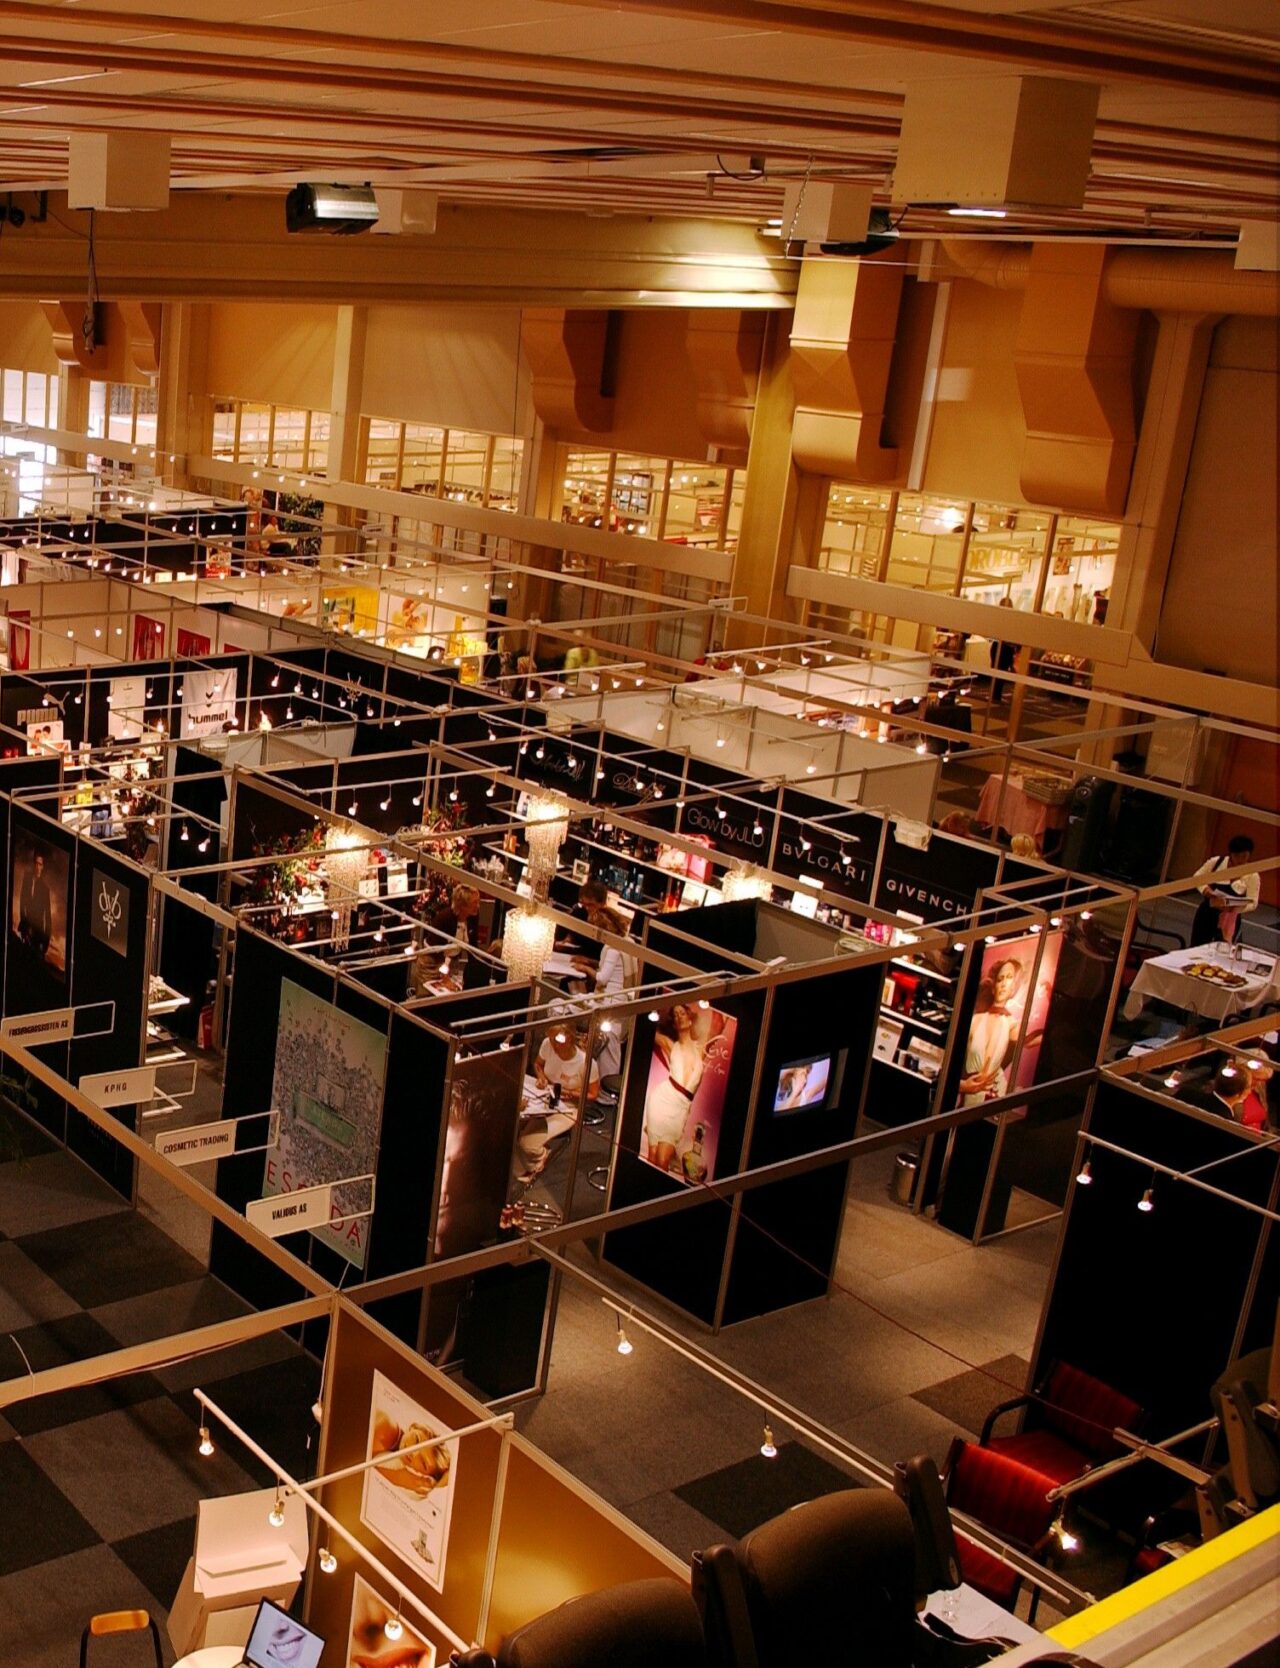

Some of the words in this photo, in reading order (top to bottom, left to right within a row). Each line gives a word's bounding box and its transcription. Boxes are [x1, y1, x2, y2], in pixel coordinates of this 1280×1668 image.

[188, 709, 228, 725] hummel
[687, 807, 719, 832] Glow
[721, 820, 737, 842] by
[782, 842, 866, 882] BVLGARI
[163, 1139, 198, 1154] COSMETIC
[199, 1133, 229, 1148] TRADING
[267, 1160, 361, 1248] ESDA
[298, 1203, 307, 1215] AS
